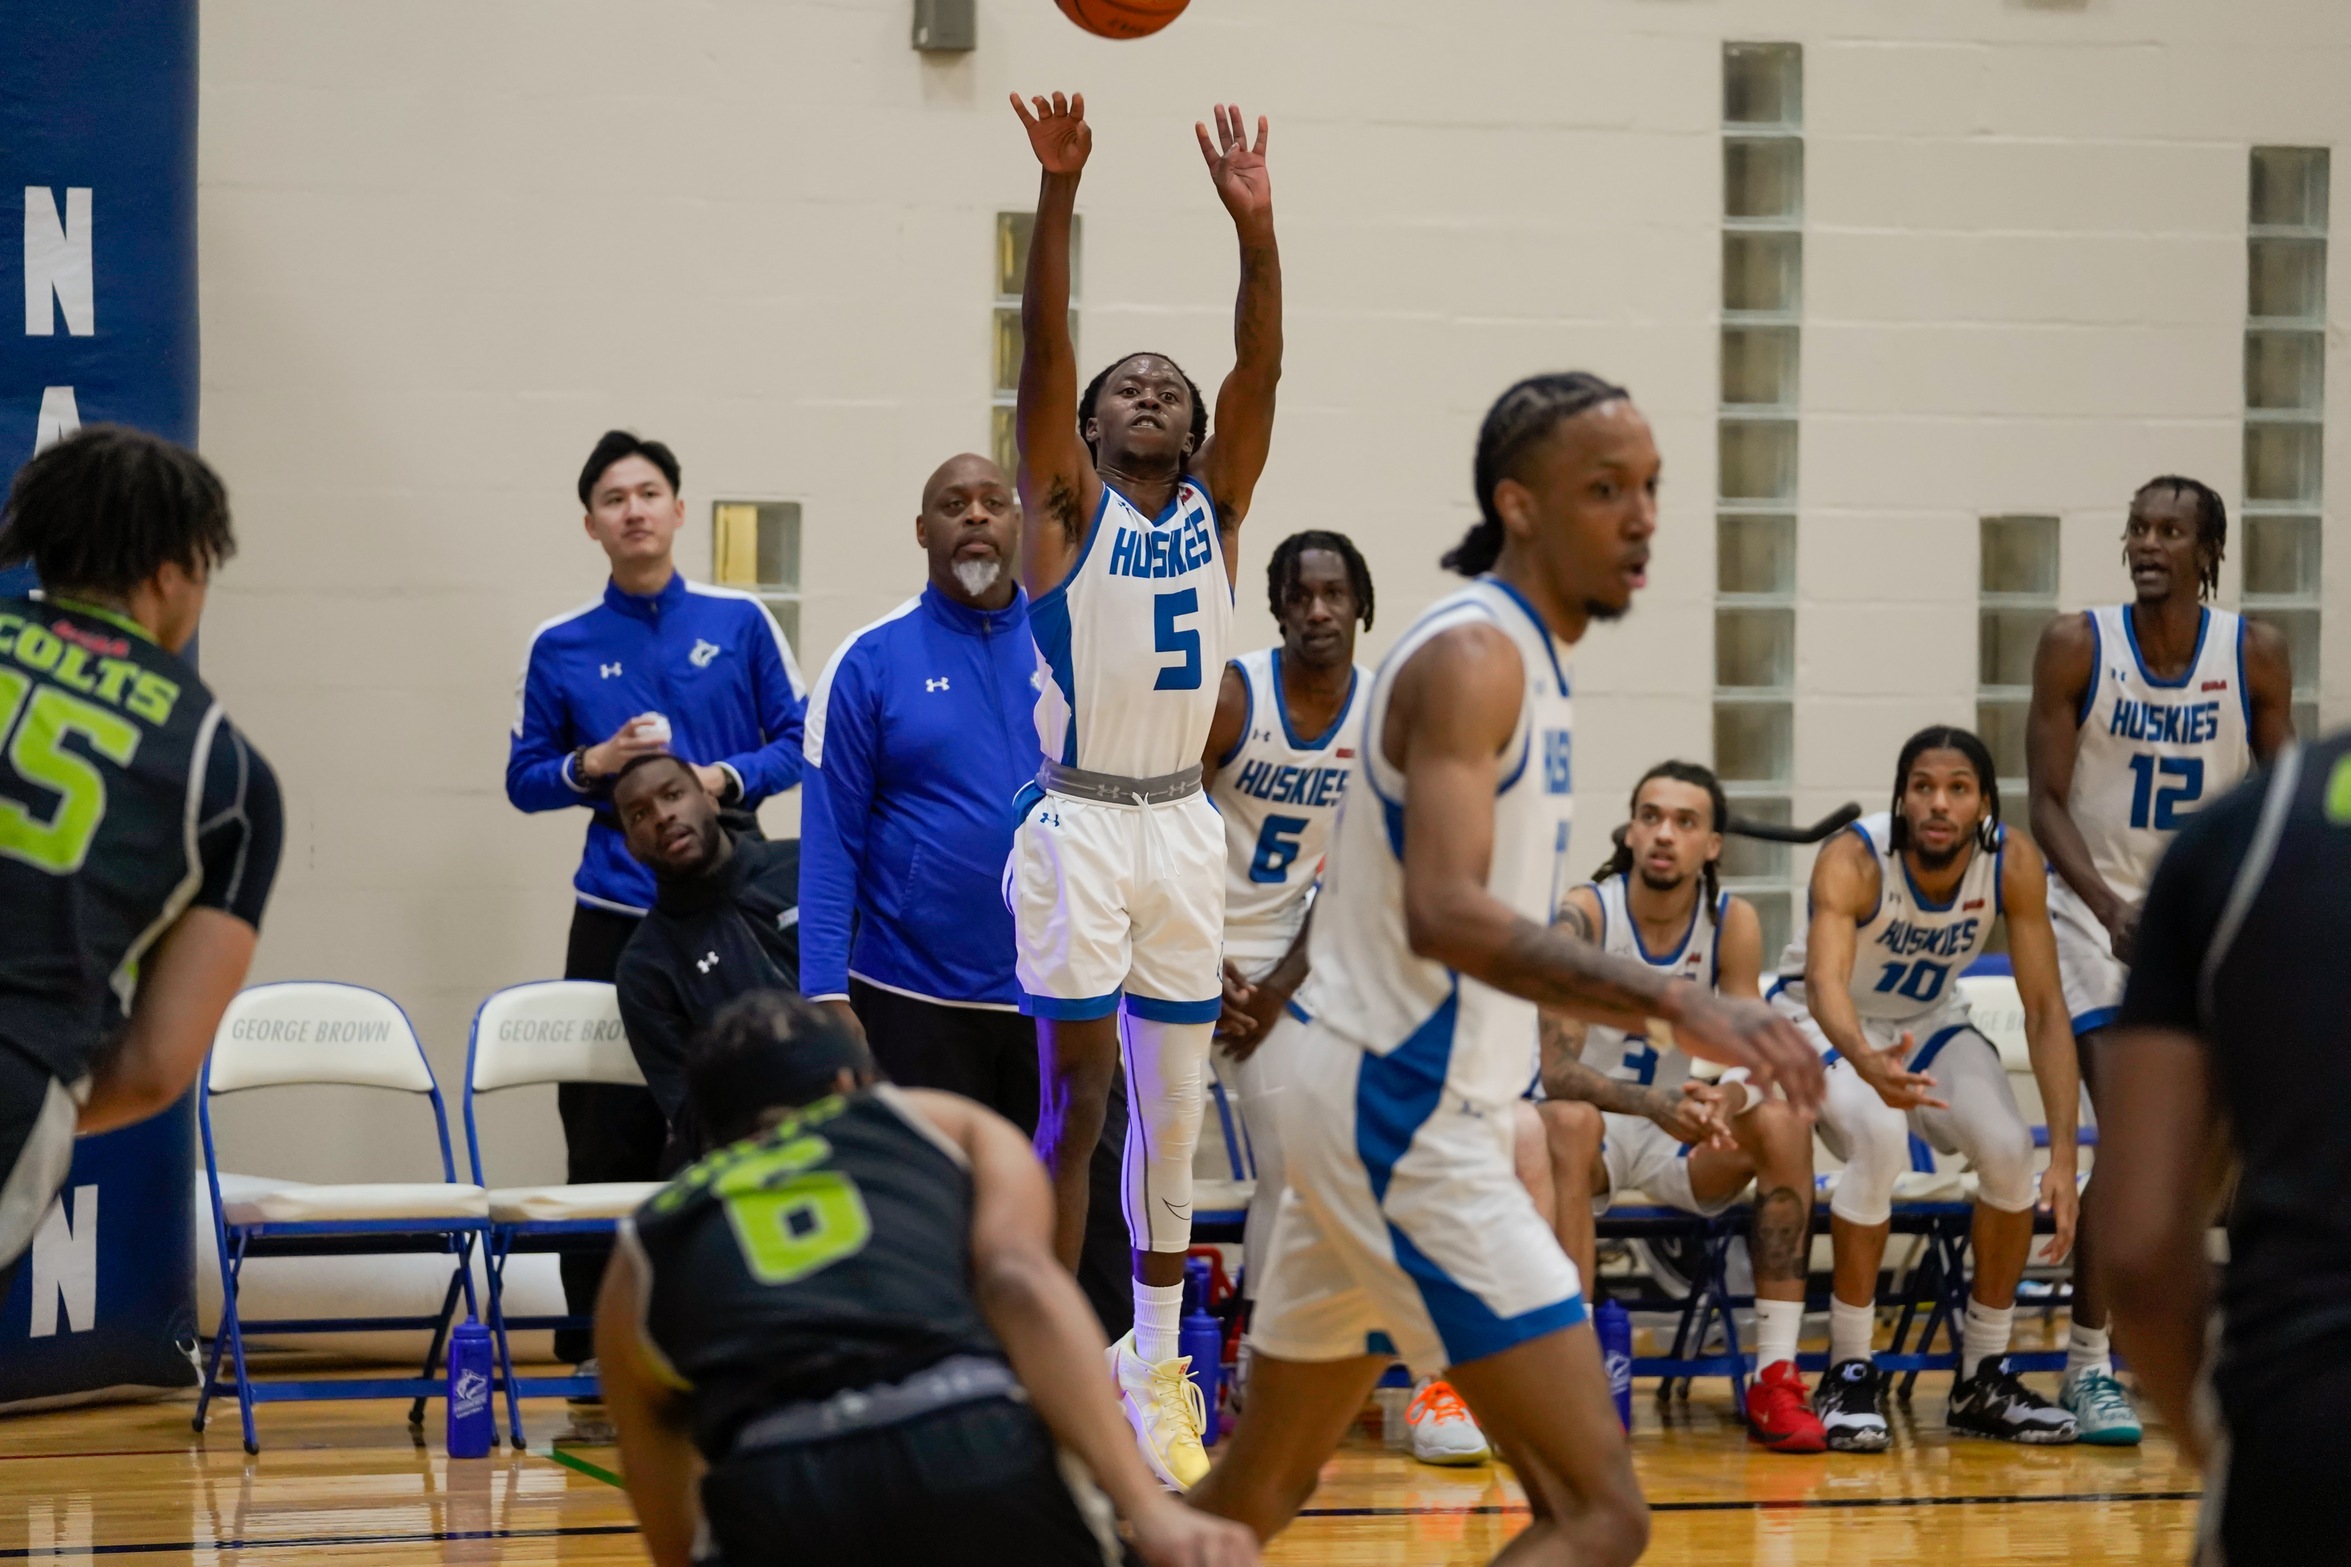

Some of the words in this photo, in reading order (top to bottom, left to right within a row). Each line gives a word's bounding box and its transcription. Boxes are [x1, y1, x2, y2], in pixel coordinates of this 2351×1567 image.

[1109, 506, 1212, 579] HUSKES
[1153, 587, 1202, 690] 5
[2110, 698, 2219, 744] HUSKIES
[1234, 759, 1350, 807] HUSKIES
[2129, 753, 2204, 830] 12
[1249, 813, 1310, 883] 6
[1875, 917, 1979, 957] HUSKIES
[1874, 958, 1952, 1002] 10
[232, 1018, 310, 1042] GEORGE
[315, 1020, 391, 1043] BROWN
[499, 1018, 577, 1042] GEORGE
[581, 1018, 628, 1042] BRO
[1622, 1034, 1659, 1086] 3
[710, 1134, 873, 1287] 6
